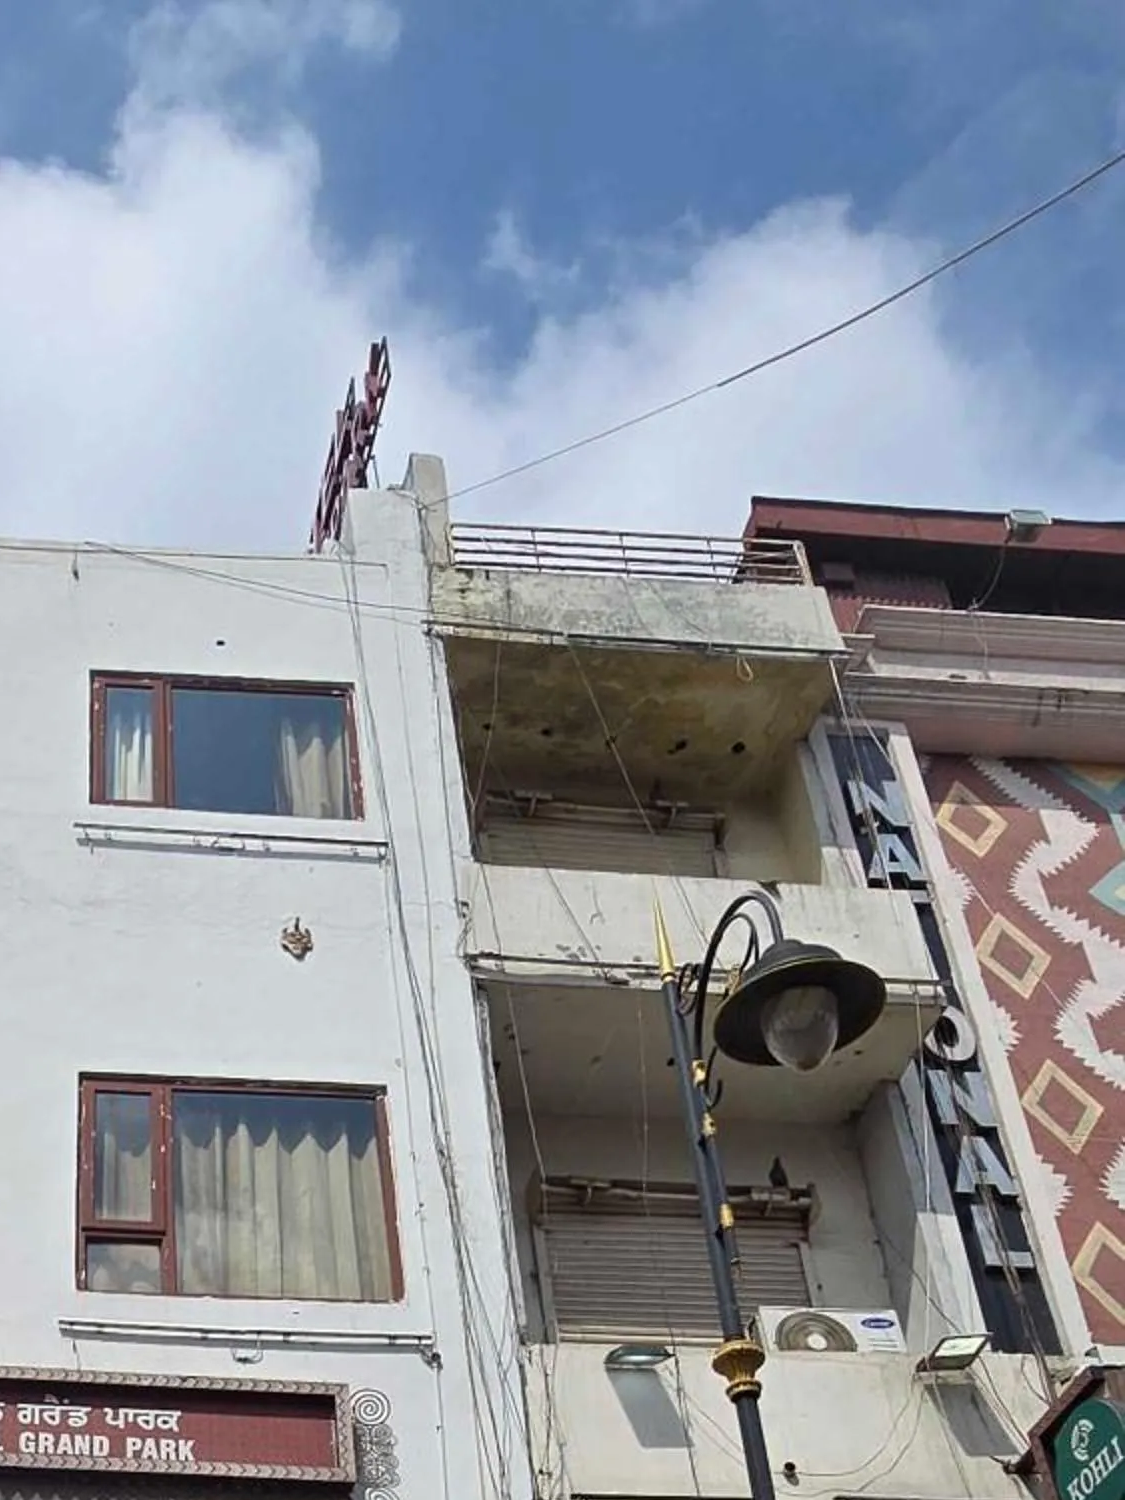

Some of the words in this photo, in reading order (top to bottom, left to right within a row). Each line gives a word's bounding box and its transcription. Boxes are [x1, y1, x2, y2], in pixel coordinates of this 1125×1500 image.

[103, 1407, 182, 1433] ਪਾਰਕ
[18, 1432, 111, 1459] GRAND
[126, 1438, 197, 1463] PARK
